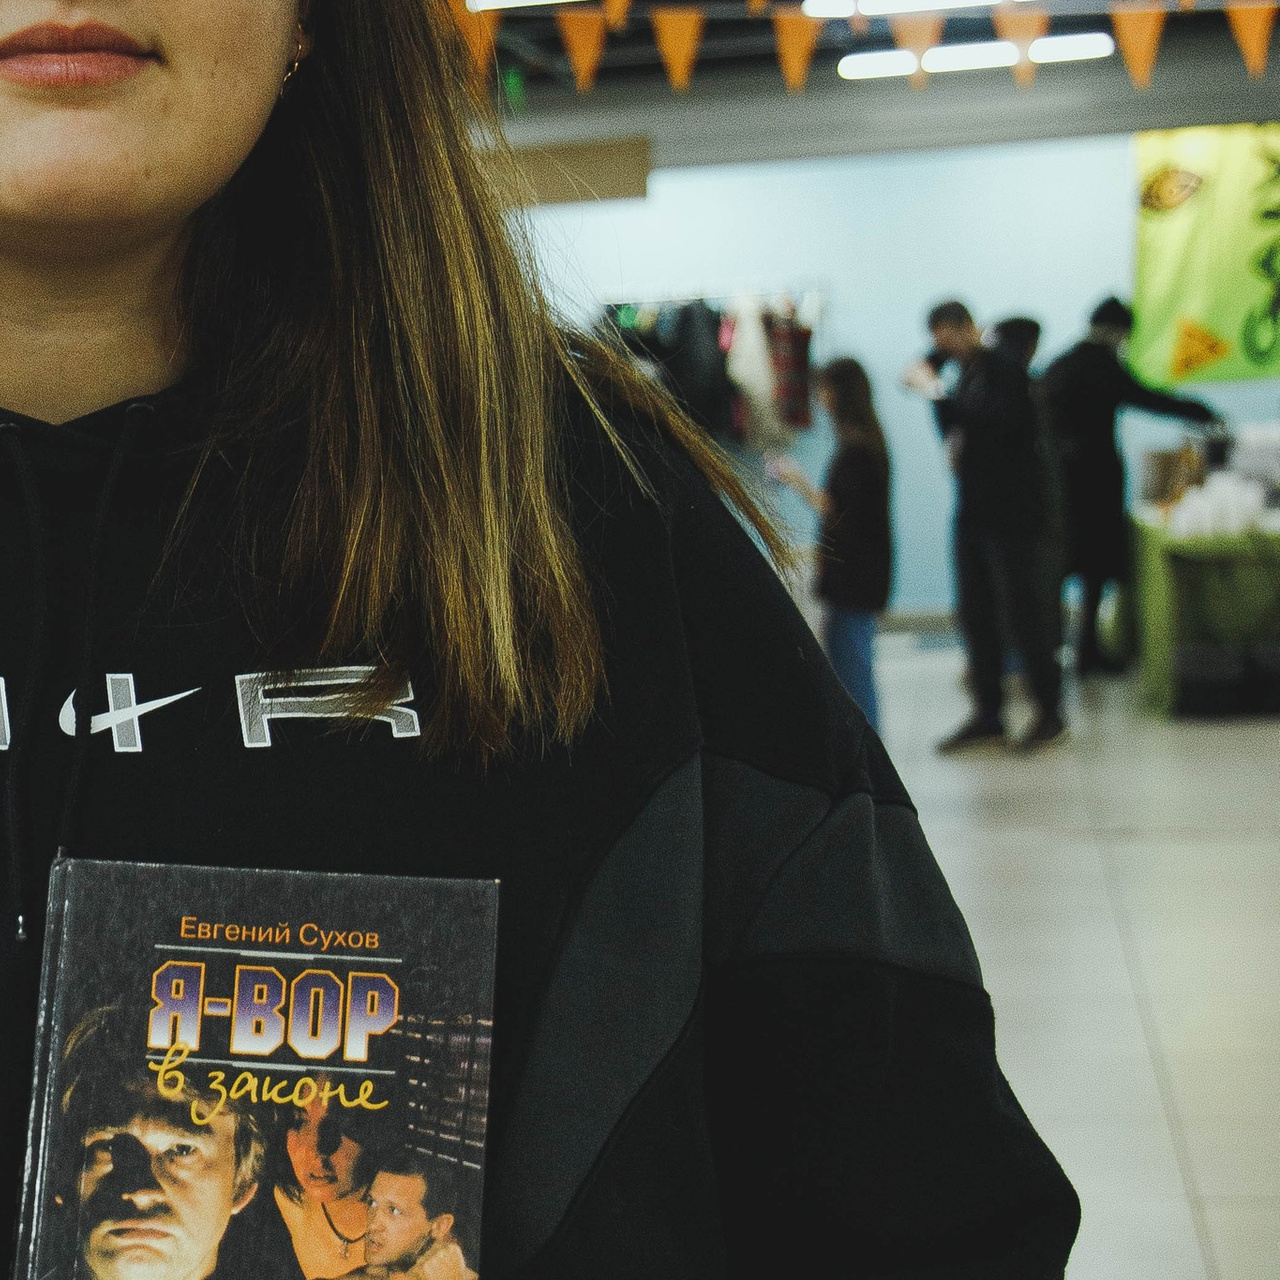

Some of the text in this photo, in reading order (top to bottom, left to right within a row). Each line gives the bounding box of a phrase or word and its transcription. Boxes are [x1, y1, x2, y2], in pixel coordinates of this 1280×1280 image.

[180, 915, 379, 951] Евгений Сухов
[147, 960, 399, 1062] Я-ВОР
[148, 1041, 389, 1126] в законе
